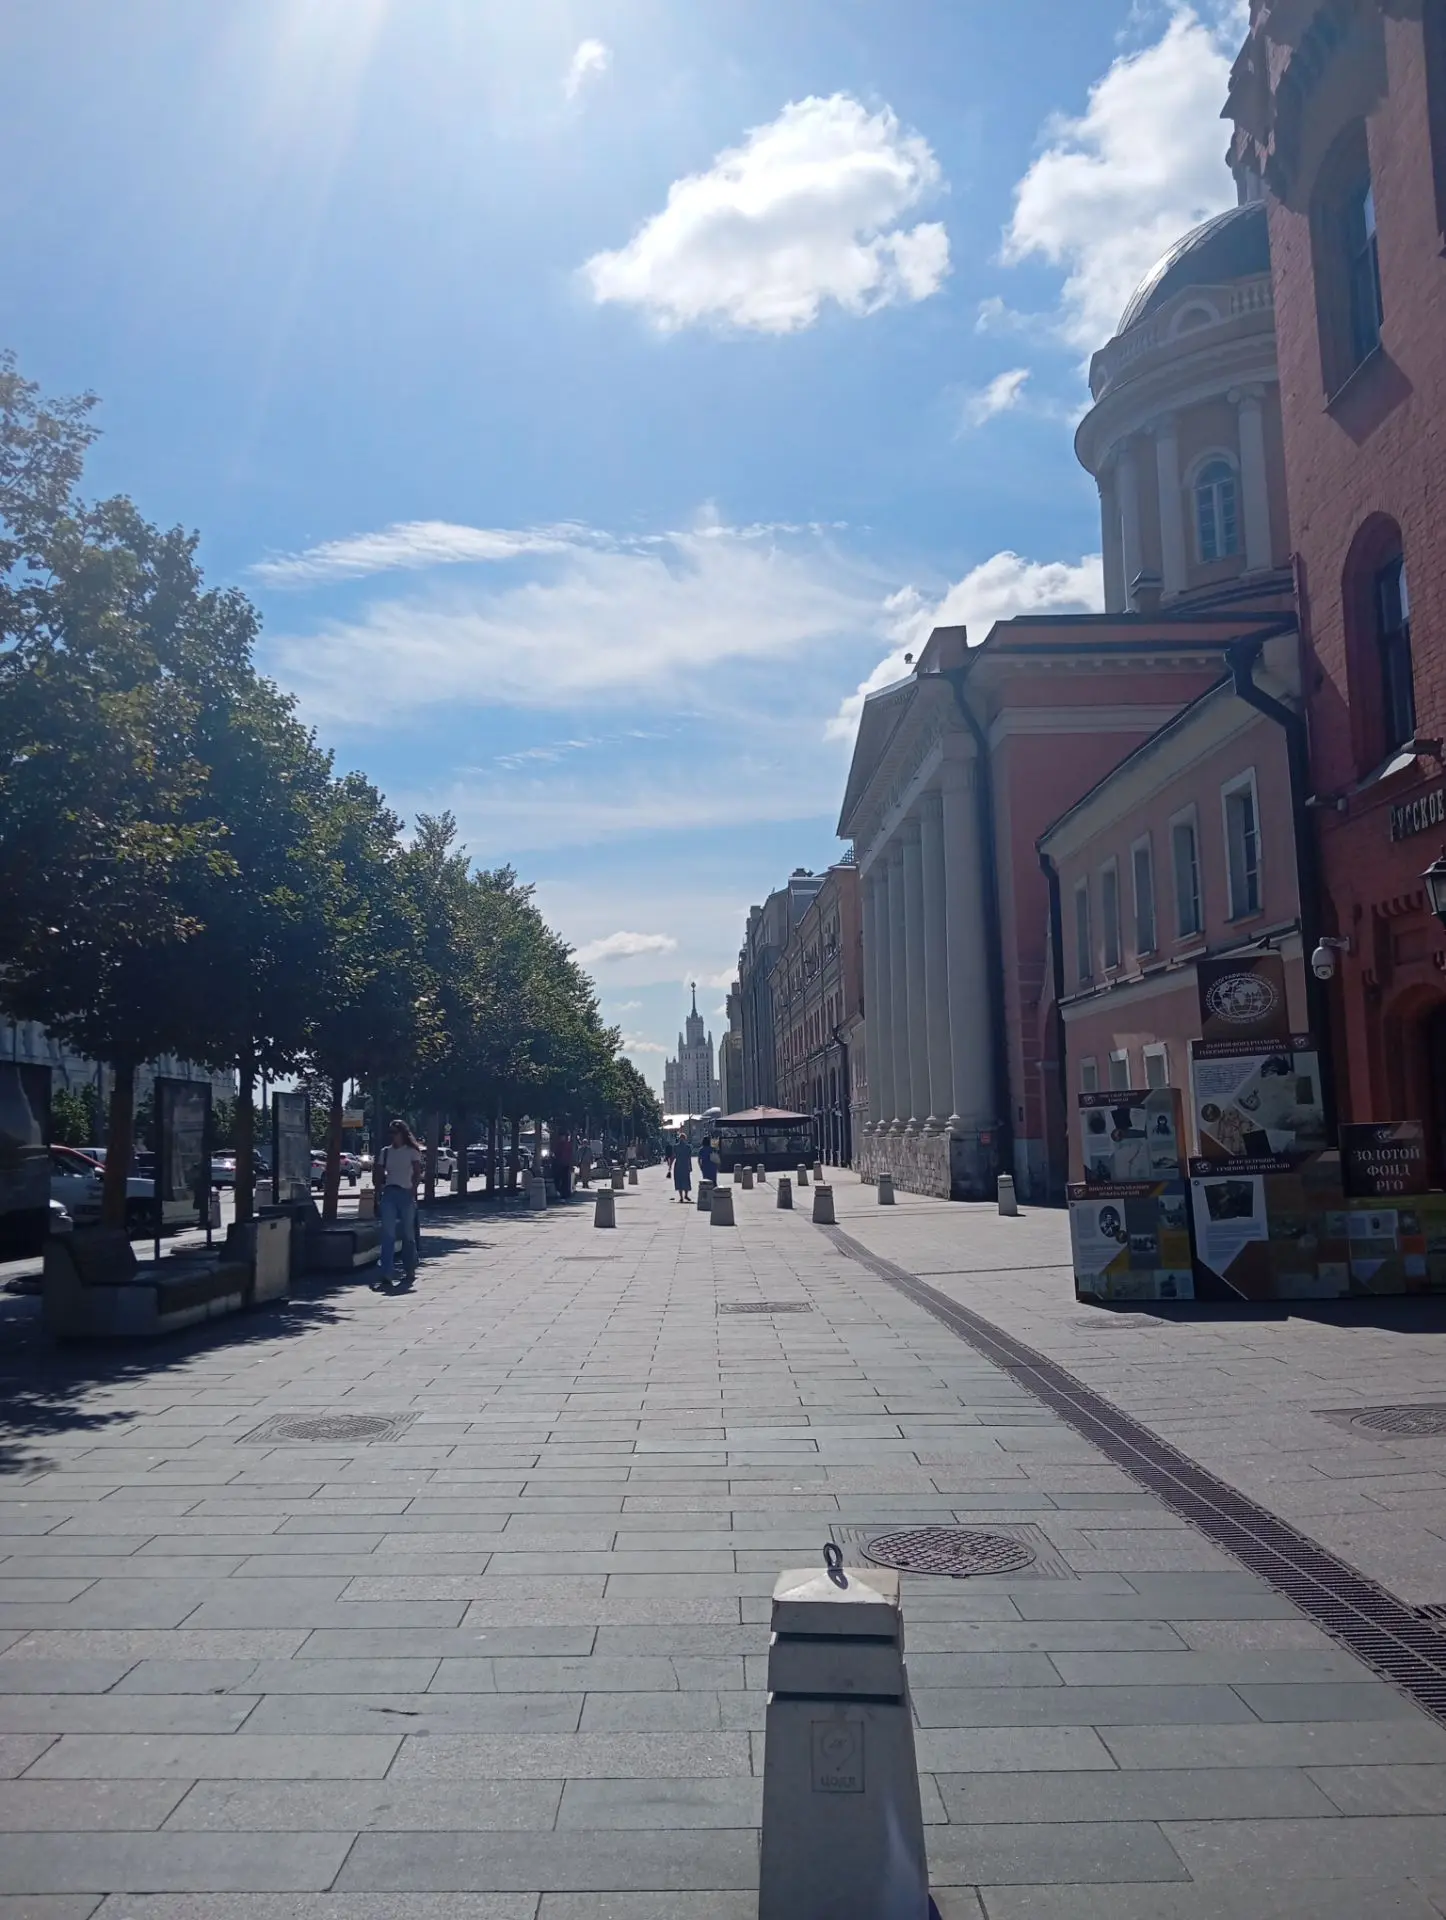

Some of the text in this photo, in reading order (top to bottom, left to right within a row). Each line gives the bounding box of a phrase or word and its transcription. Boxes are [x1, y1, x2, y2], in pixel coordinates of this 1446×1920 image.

[1353, 1145, 1420, 1161] ЗОЛОТОЙ
[1367, 1164, 1411, 1177] ФОНД
[1377, 1180, 1404, 1191] РГО
